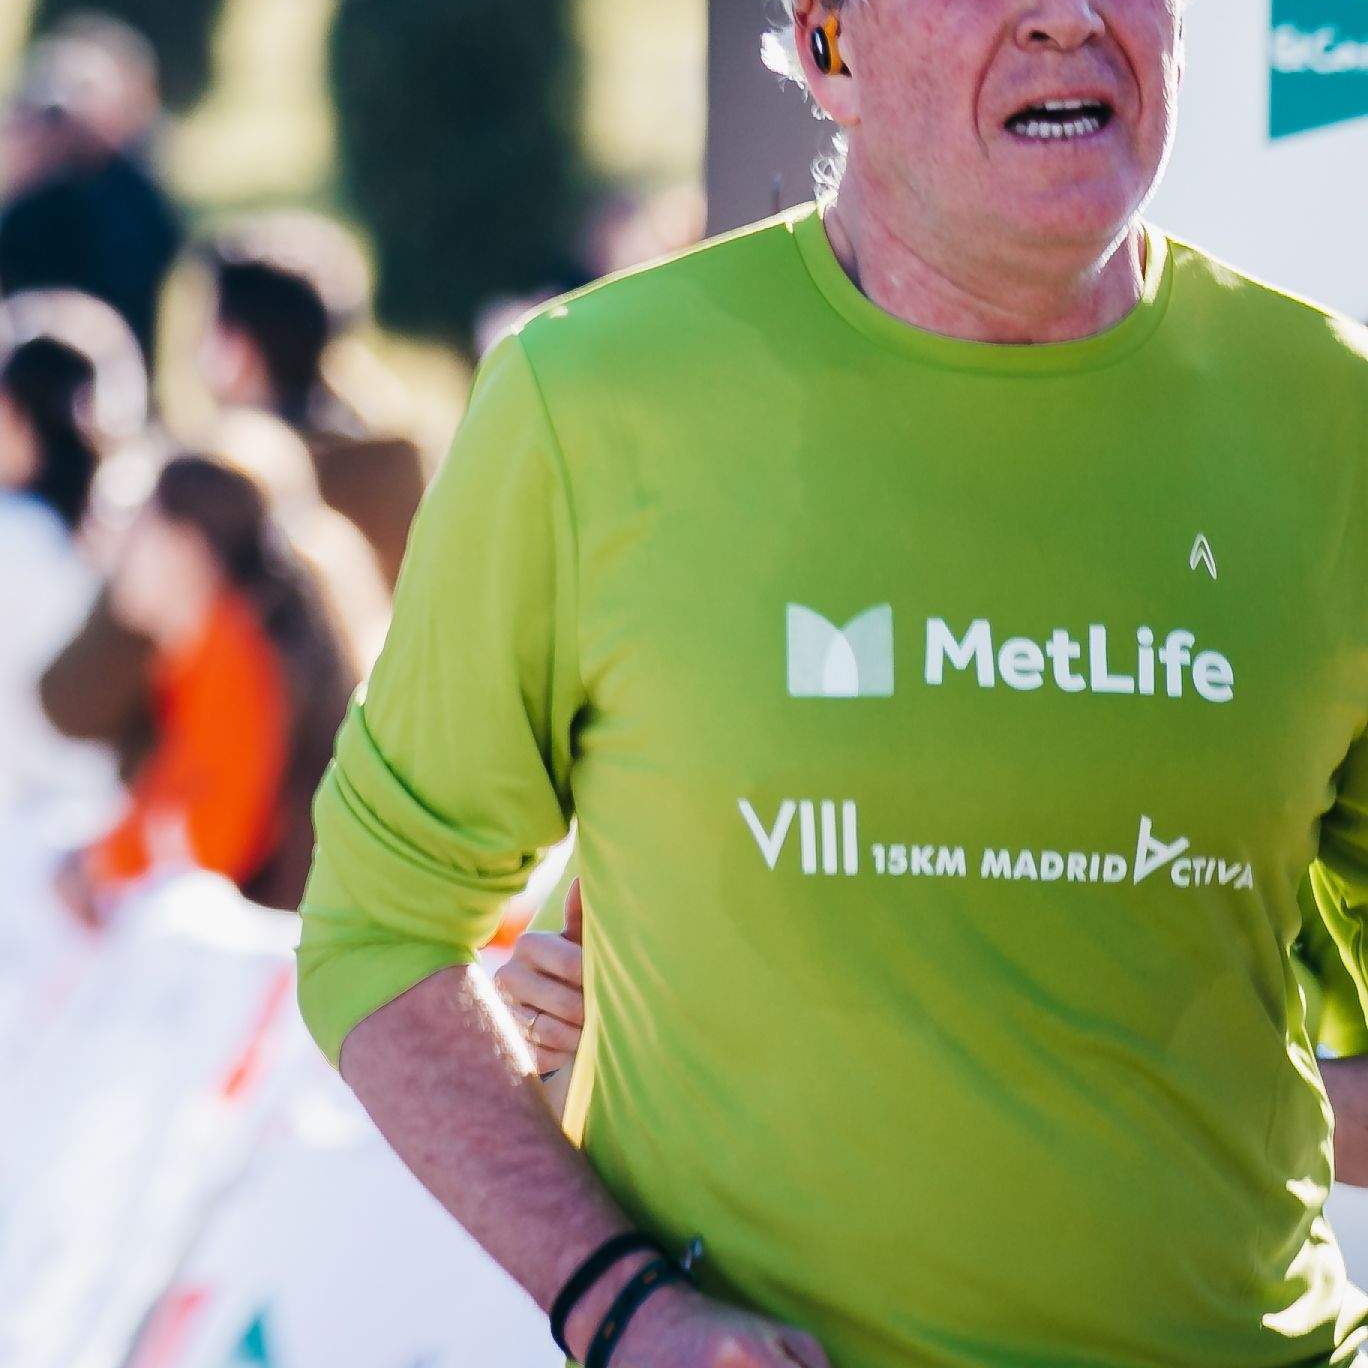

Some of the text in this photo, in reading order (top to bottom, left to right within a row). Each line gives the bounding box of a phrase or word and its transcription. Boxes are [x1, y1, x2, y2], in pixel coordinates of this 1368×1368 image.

[924, 616, 1234, 702] MetLife
[737, 798, 859, 874] VIII
[872, 842, 966, 878] 15KM
[980, 848, 1128, 883] MADRID
